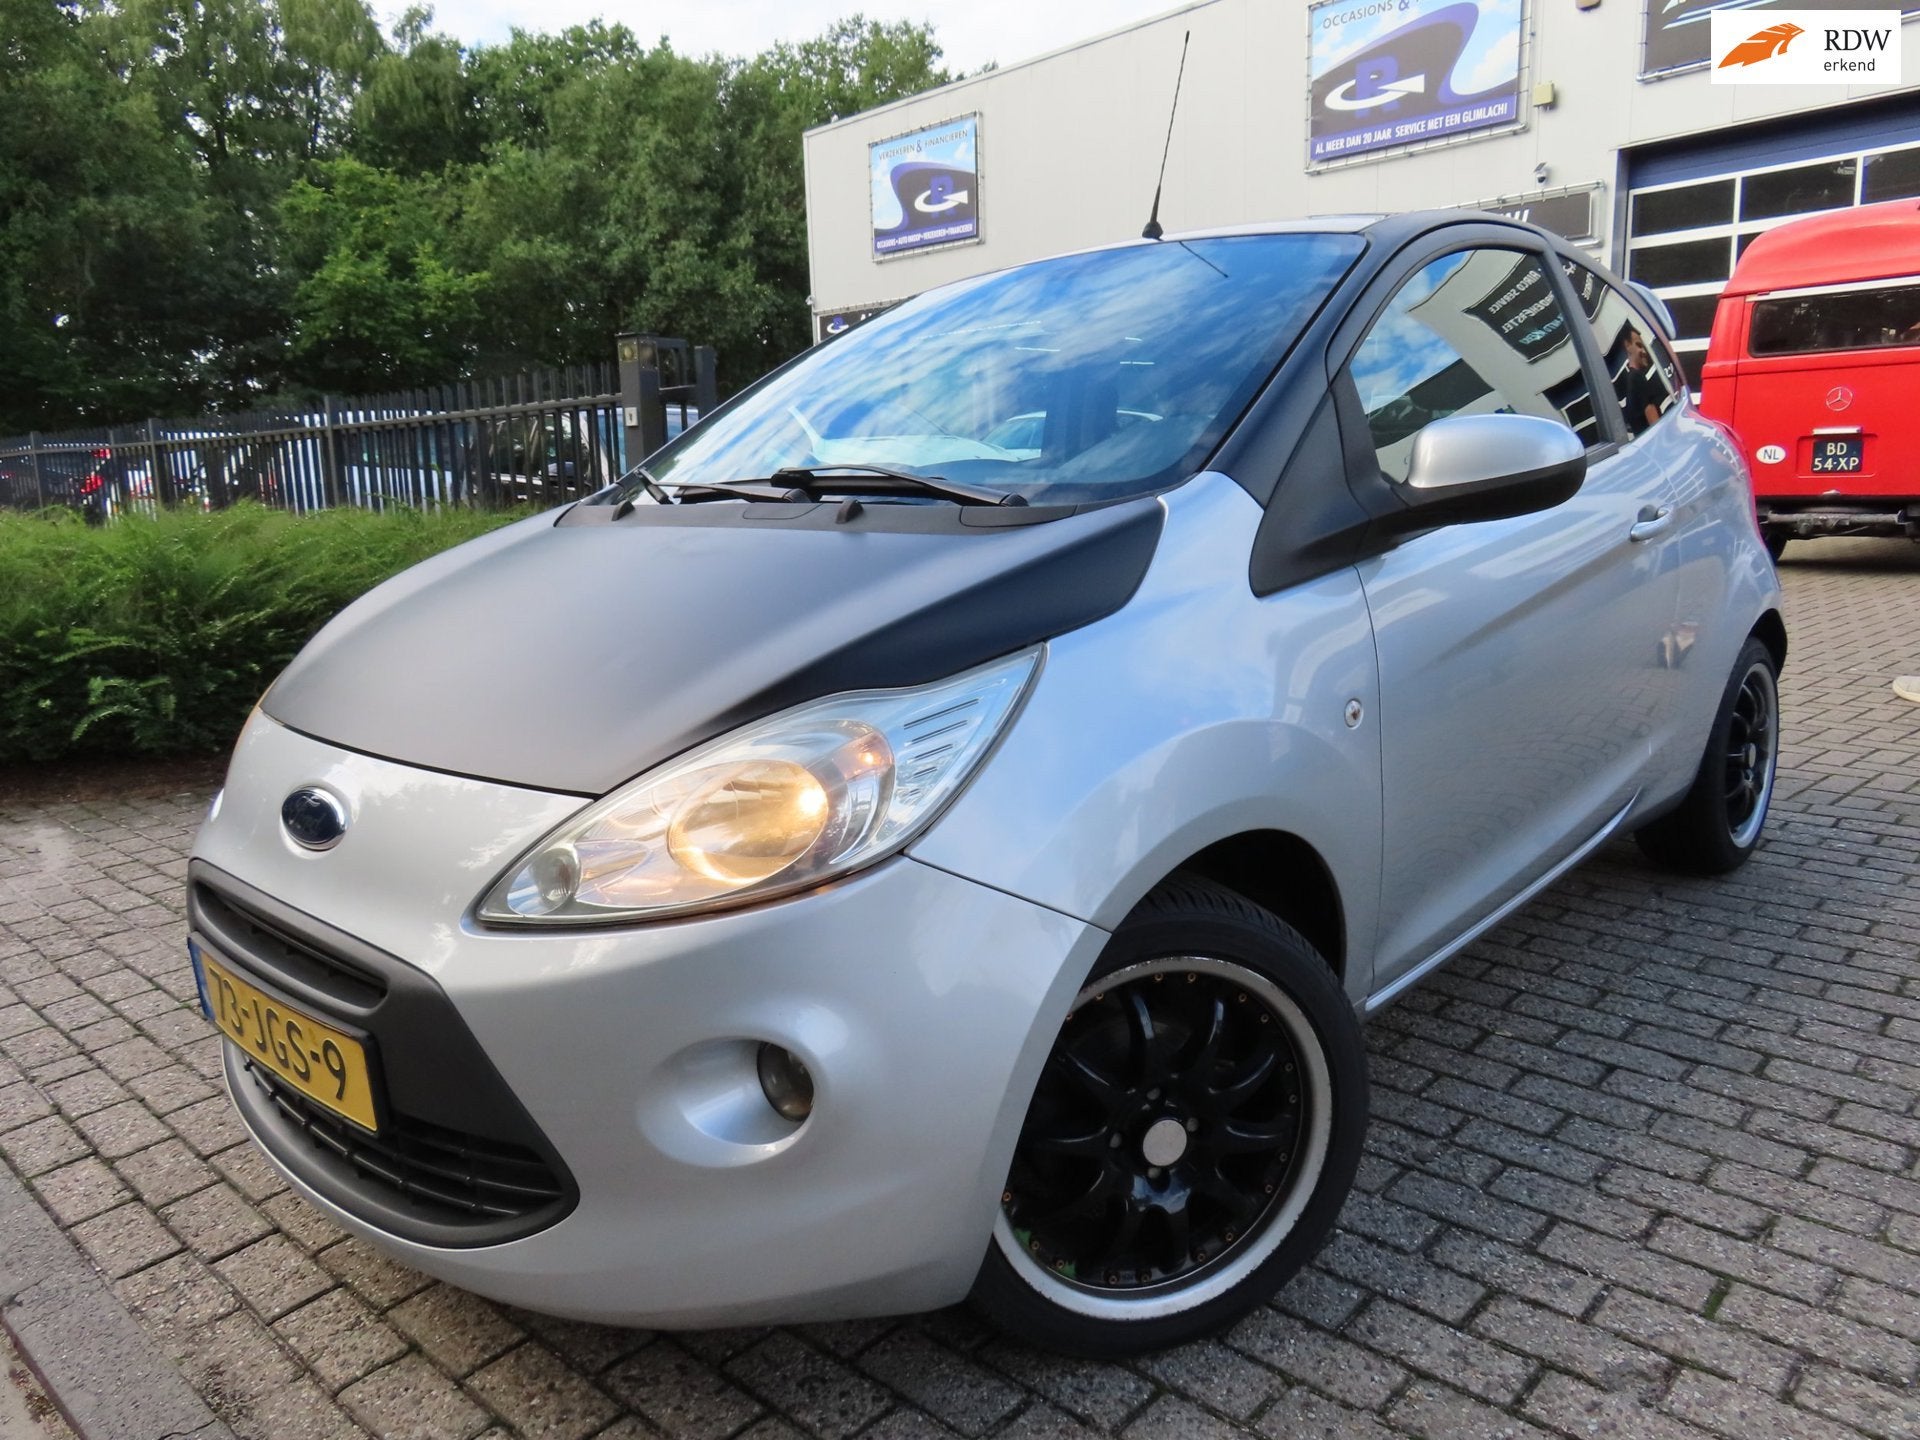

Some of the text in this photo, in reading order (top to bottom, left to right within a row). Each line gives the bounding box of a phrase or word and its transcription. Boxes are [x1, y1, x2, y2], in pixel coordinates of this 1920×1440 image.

[1322, 1, 1393, 29] OCCASIONS
[1315, 102, 1508, 155] AL MEER DAN 20 JAAR SERVICE MET EEN GLIMLACH!
[878, 143, 915, 161] VERZEKEREN
[924, 129, 968, 147] FINANCIEREN
[1763, 448, 1779, 460] NL
[1826, 442, 1847, 455] BD
[1813, 457, 1860, 471] 54-XP
[209, 963, 347, 1100] 73-JGS-9
